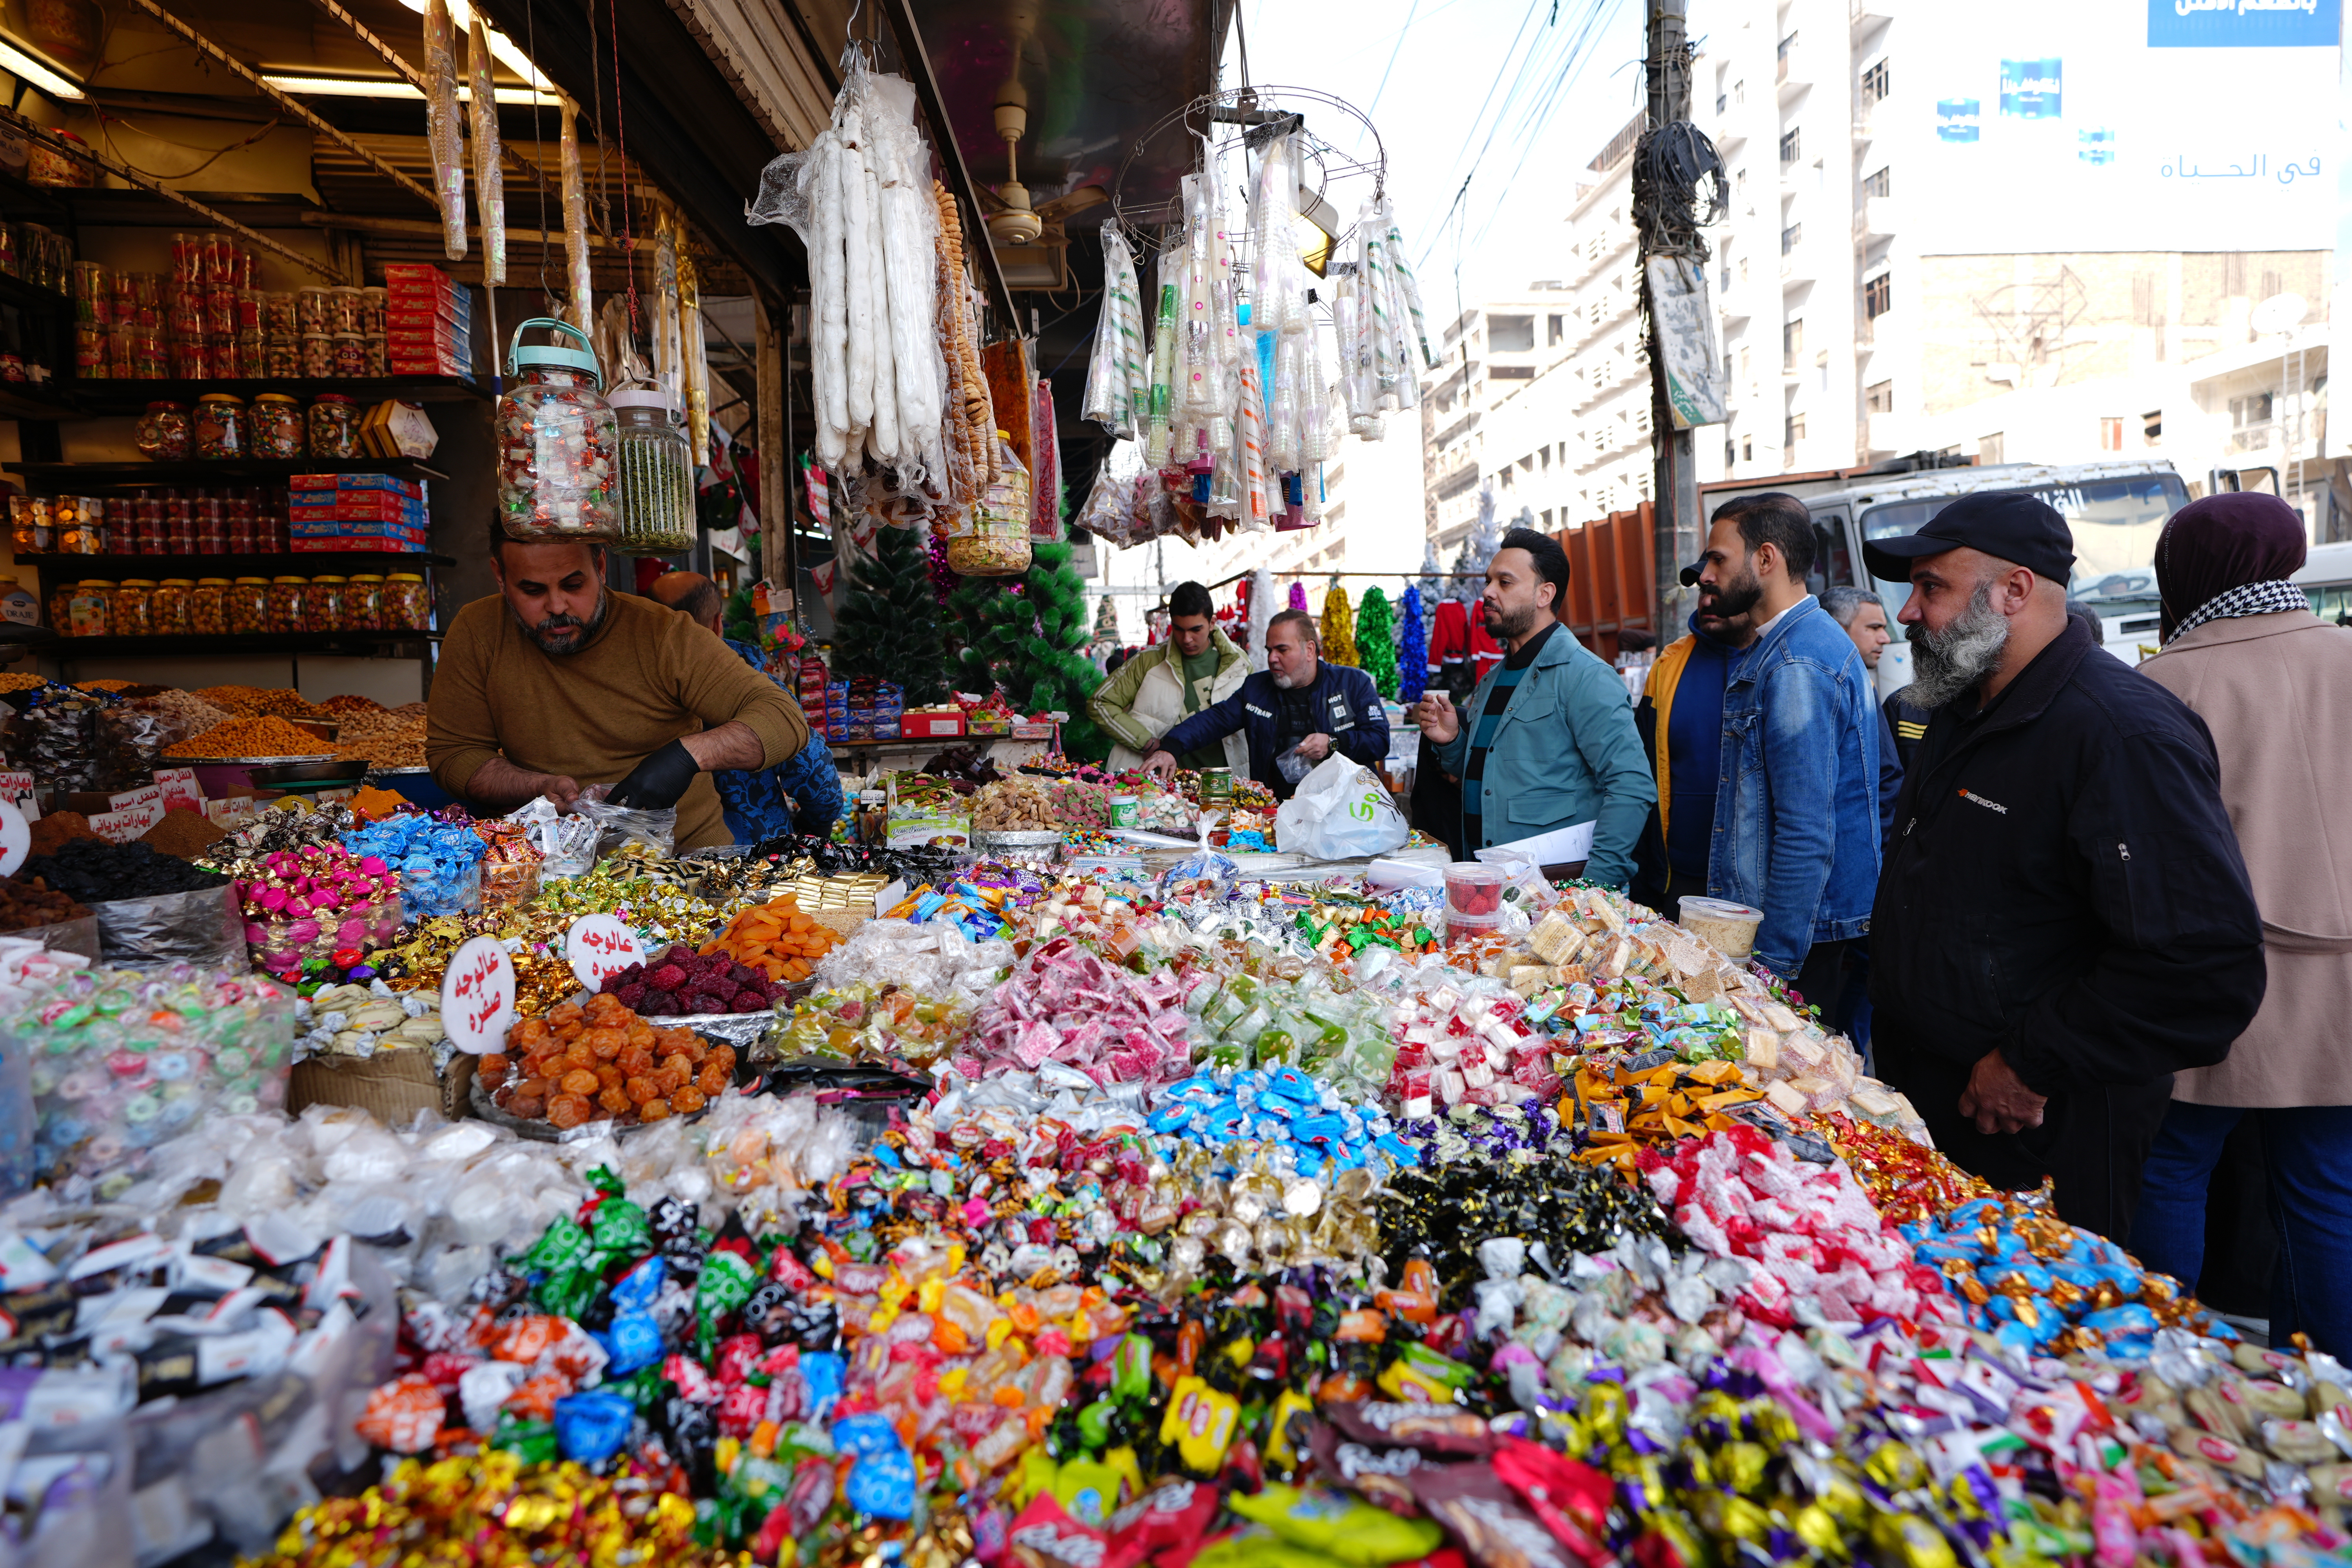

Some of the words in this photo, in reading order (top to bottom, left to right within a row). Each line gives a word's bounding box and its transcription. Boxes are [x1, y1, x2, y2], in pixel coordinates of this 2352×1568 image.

[2161, 152, 2266, 185] الحياة
[2277, 149, 2321, 192] في
[6, 609, 34, 619] DRAJE
[1328, 694, 1342, 704] HOT
[1245, 703, 1272, 718] HOTRAW
[1336, 707, 1344, 715] 95
[1334, 721, 1355, 732] FASHION
[0, 775, 31, 791] بهارات
[176, 770, 192, 783] فلفل
[115, 797, 134, 810] اسود
[137, 791, 159, 805] فلفل
[122, 813, 151, 828] بهارات
[583, 928, 633, 955] عالوجه
[455, 949, 499, 999] عالوجه
